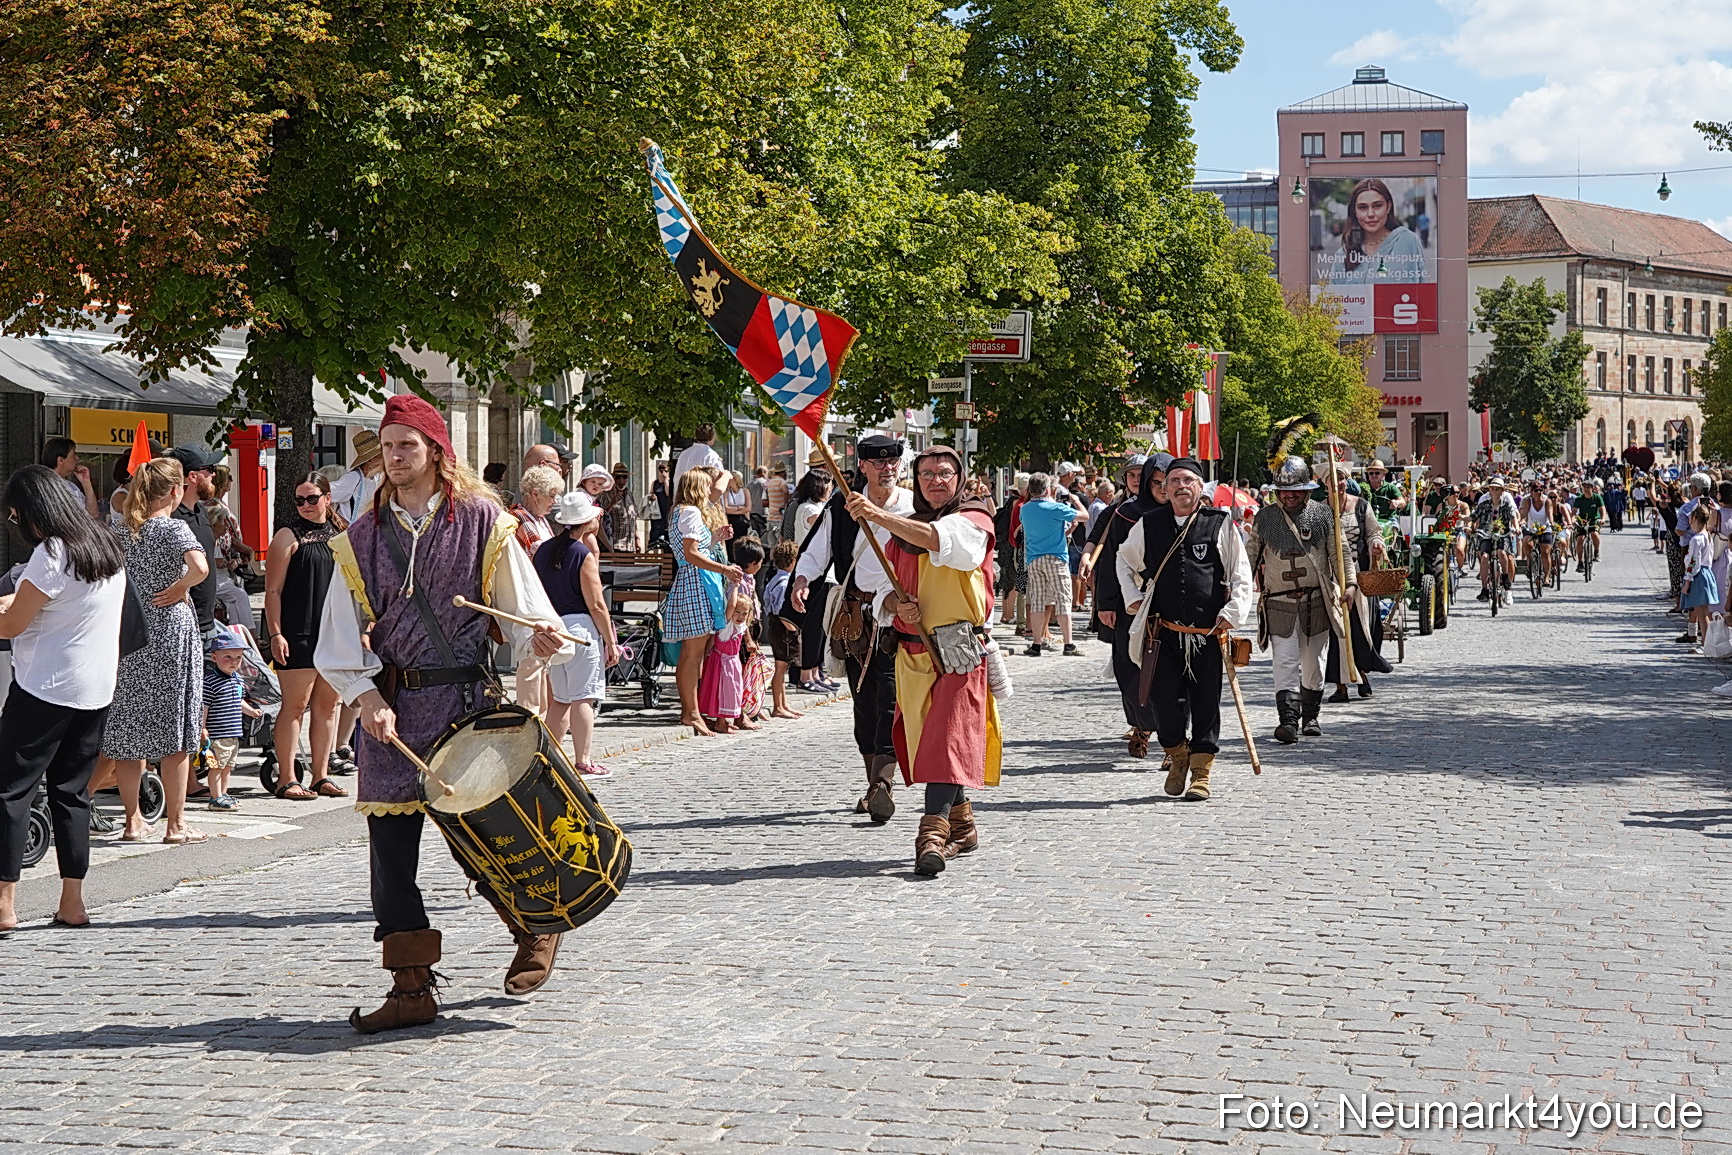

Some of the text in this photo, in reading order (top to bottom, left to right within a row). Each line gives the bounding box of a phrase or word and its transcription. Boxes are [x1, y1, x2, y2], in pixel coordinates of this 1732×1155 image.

[1317, 253, 1346, 263] Mehr
[1317, 268, 1432, 281] Weniger Skgasse.
[967, 341, 1006, 353] sengasse
[931, 380, 962, 391] Rosengasse
[1380, 393, 1423, 406] kasse
[111, 428, 168, 445] SCHERF
[495, 846, 540, 865] Johann
[512, 865, 546, 880] und die
[524, 878, 558, 900] Pfalz
